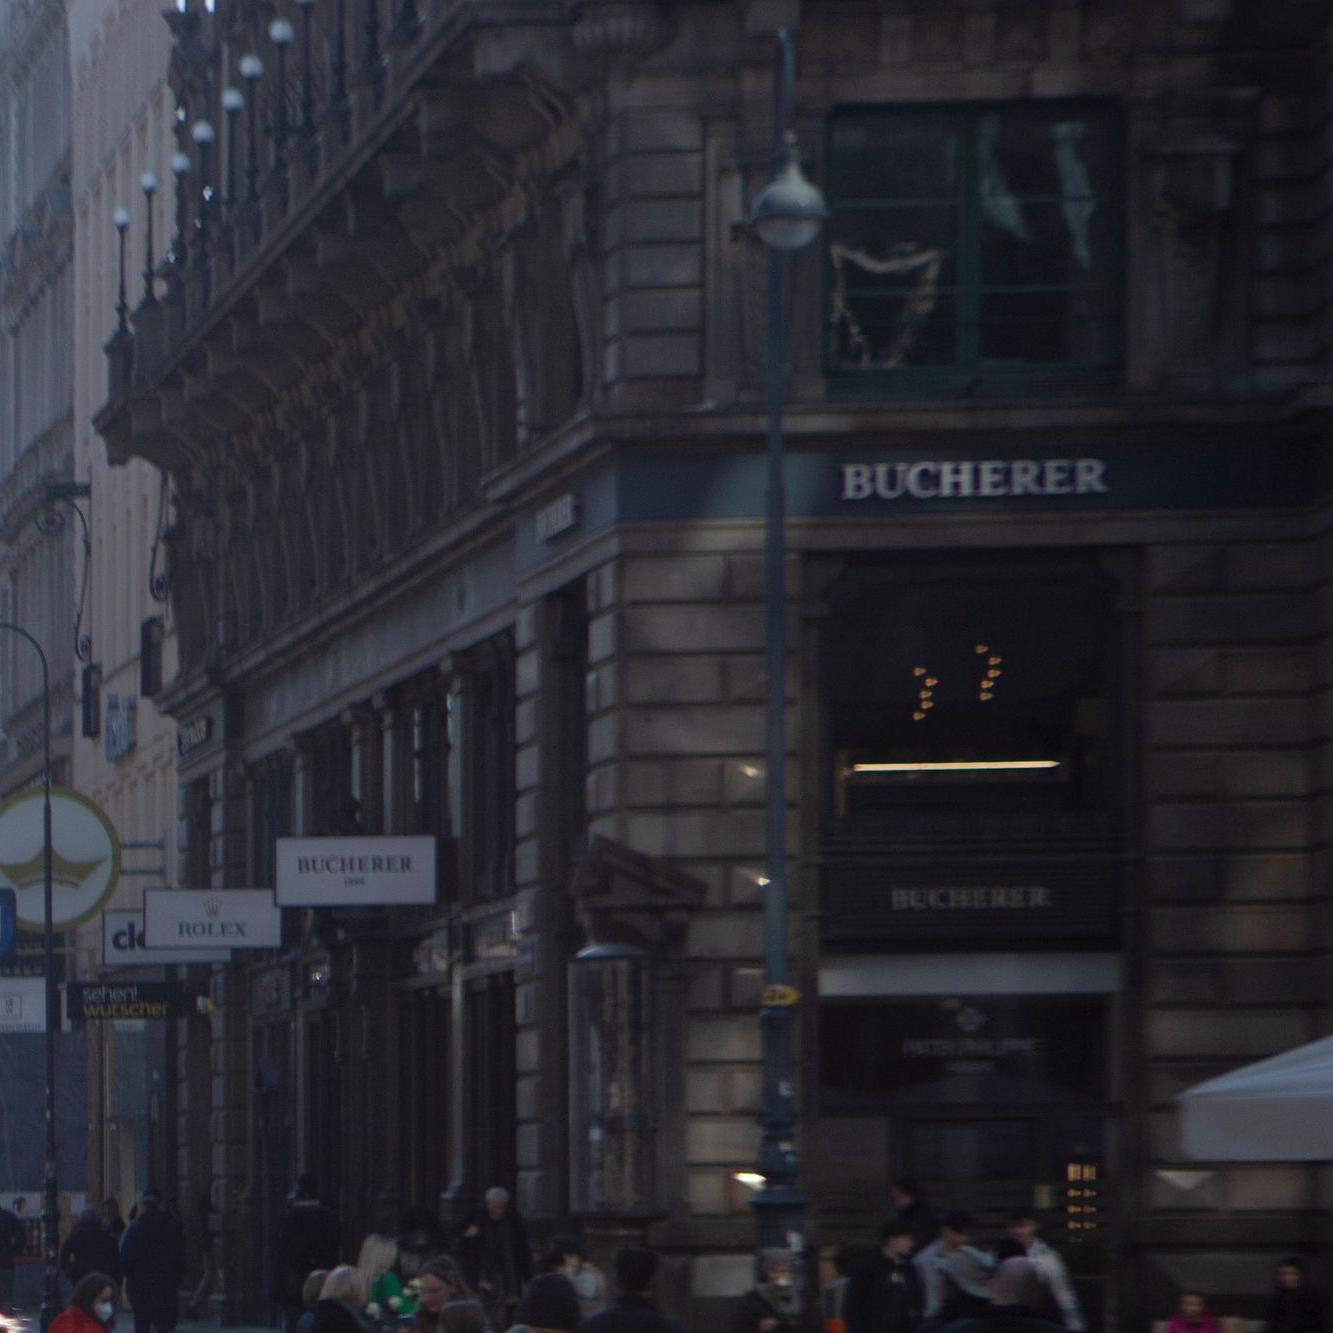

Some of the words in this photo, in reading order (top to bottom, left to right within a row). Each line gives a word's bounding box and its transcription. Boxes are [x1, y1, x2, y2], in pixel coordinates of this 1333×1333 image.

[843, 458, 1108, 500] BUCHERER
[296, 854, 412, 873] BUCHERER
[891, 885, 1052, 910] BUCHERER
[178, 921, 246, 937] ROLEX
